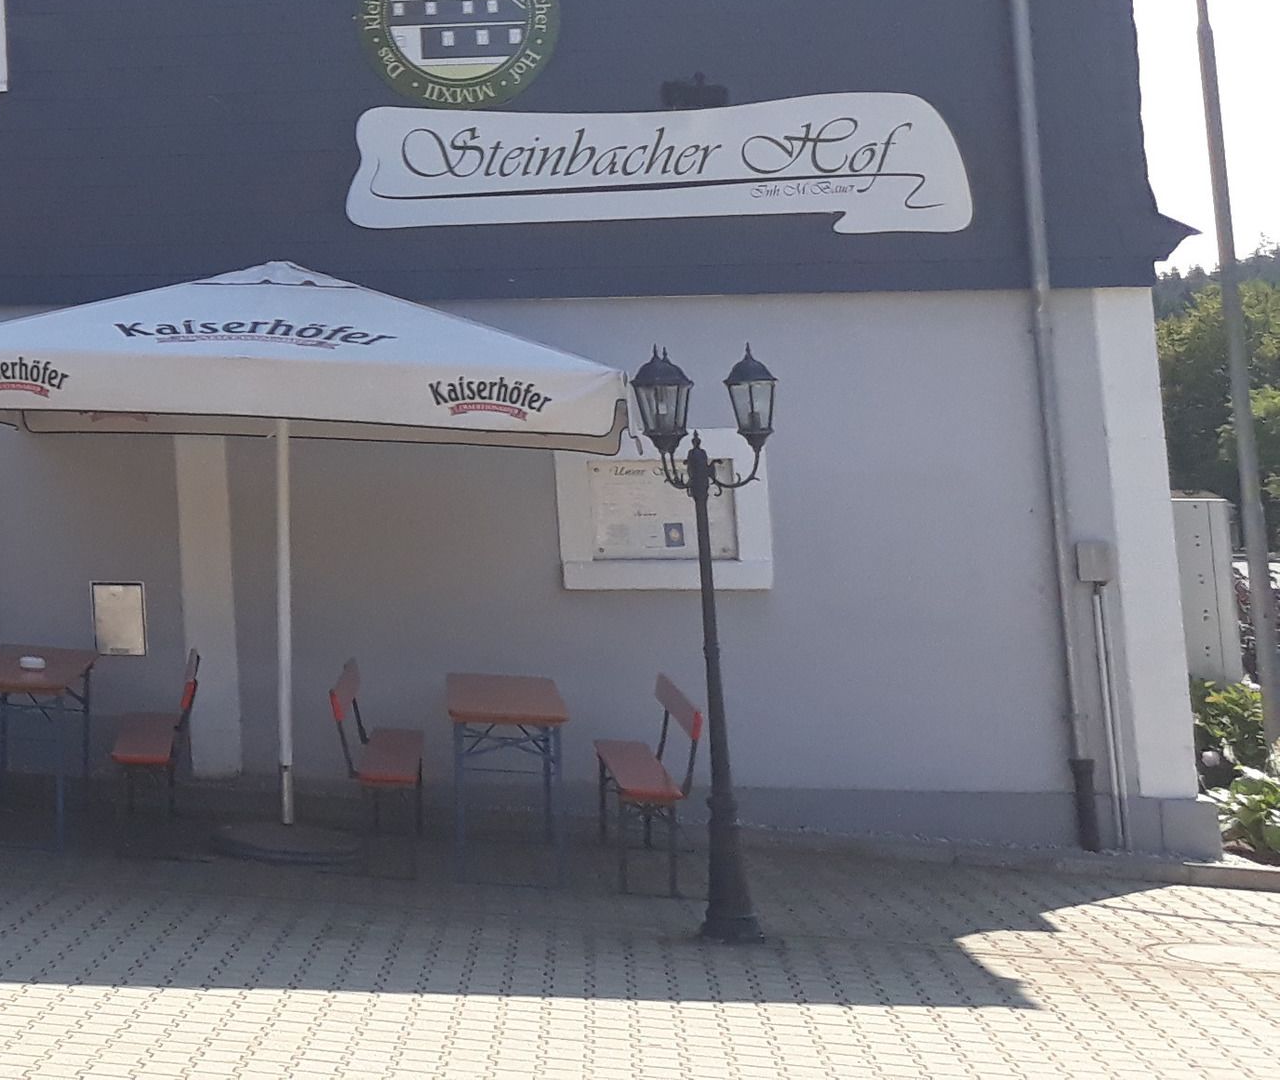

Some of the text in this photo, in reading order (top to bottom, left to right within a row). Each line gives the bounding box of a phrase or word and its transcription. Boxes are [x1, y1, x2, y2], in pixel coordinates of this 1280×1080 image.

[378, 46, 406, 80] Das
[509, 48, 541, 86] Hof
[424, 82, 496, 104] MMXII
[401, 117, 913, 193] Steinbacher Hof
[113, 319, 398, 346] Kaiserhöfer
[428, 376, 553, 413] Kaiserhöfer
